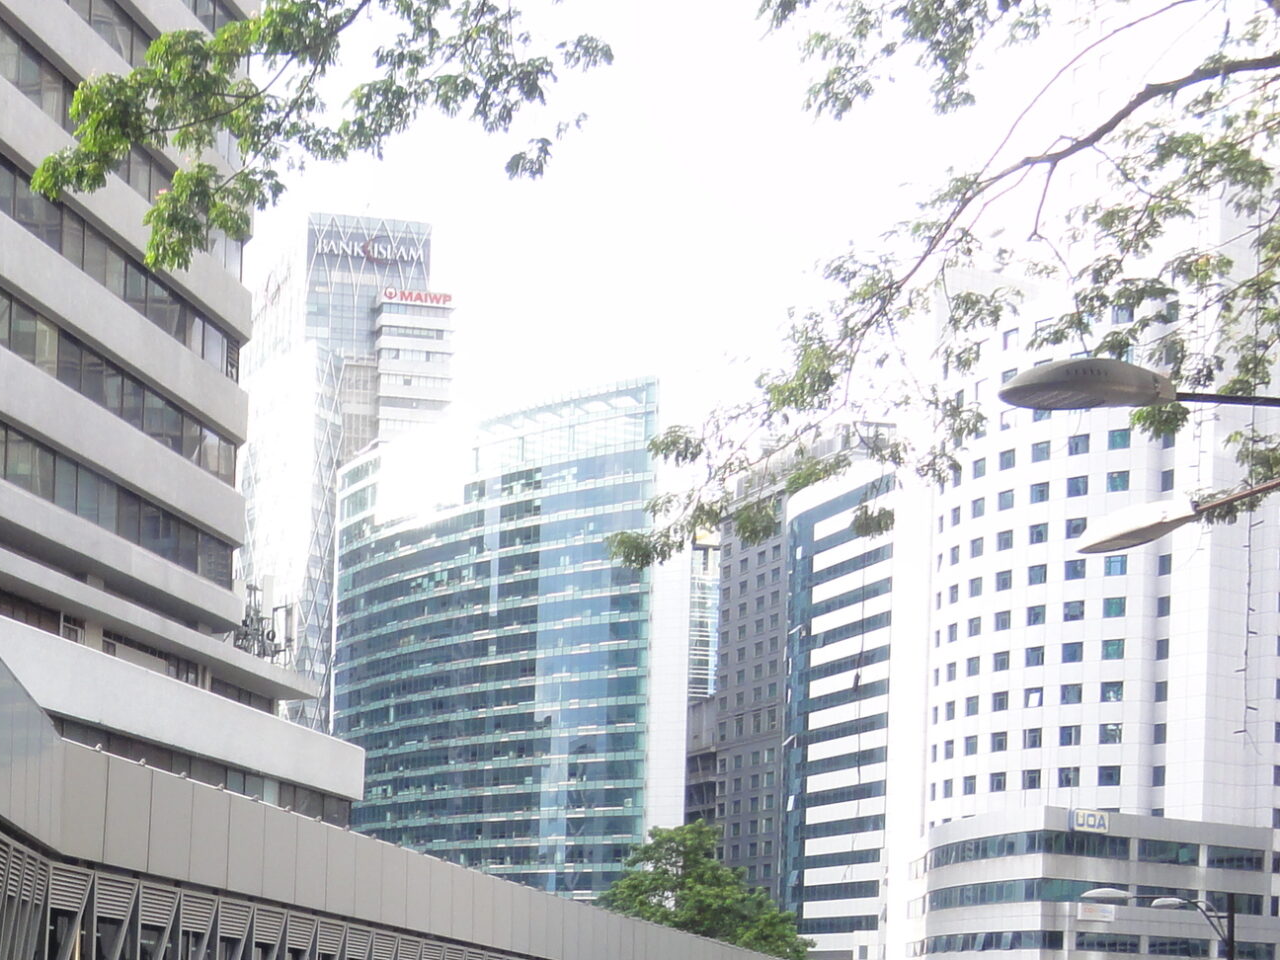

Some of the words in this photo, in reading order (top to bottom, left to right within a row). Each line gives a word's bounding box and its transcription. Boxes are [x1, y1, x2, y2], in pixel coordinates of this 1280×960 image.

[317, 239, 364, 257] BANK
[373, 242, 425, 262] ISLAM
[399, 290, 453, 305] MAIWP
